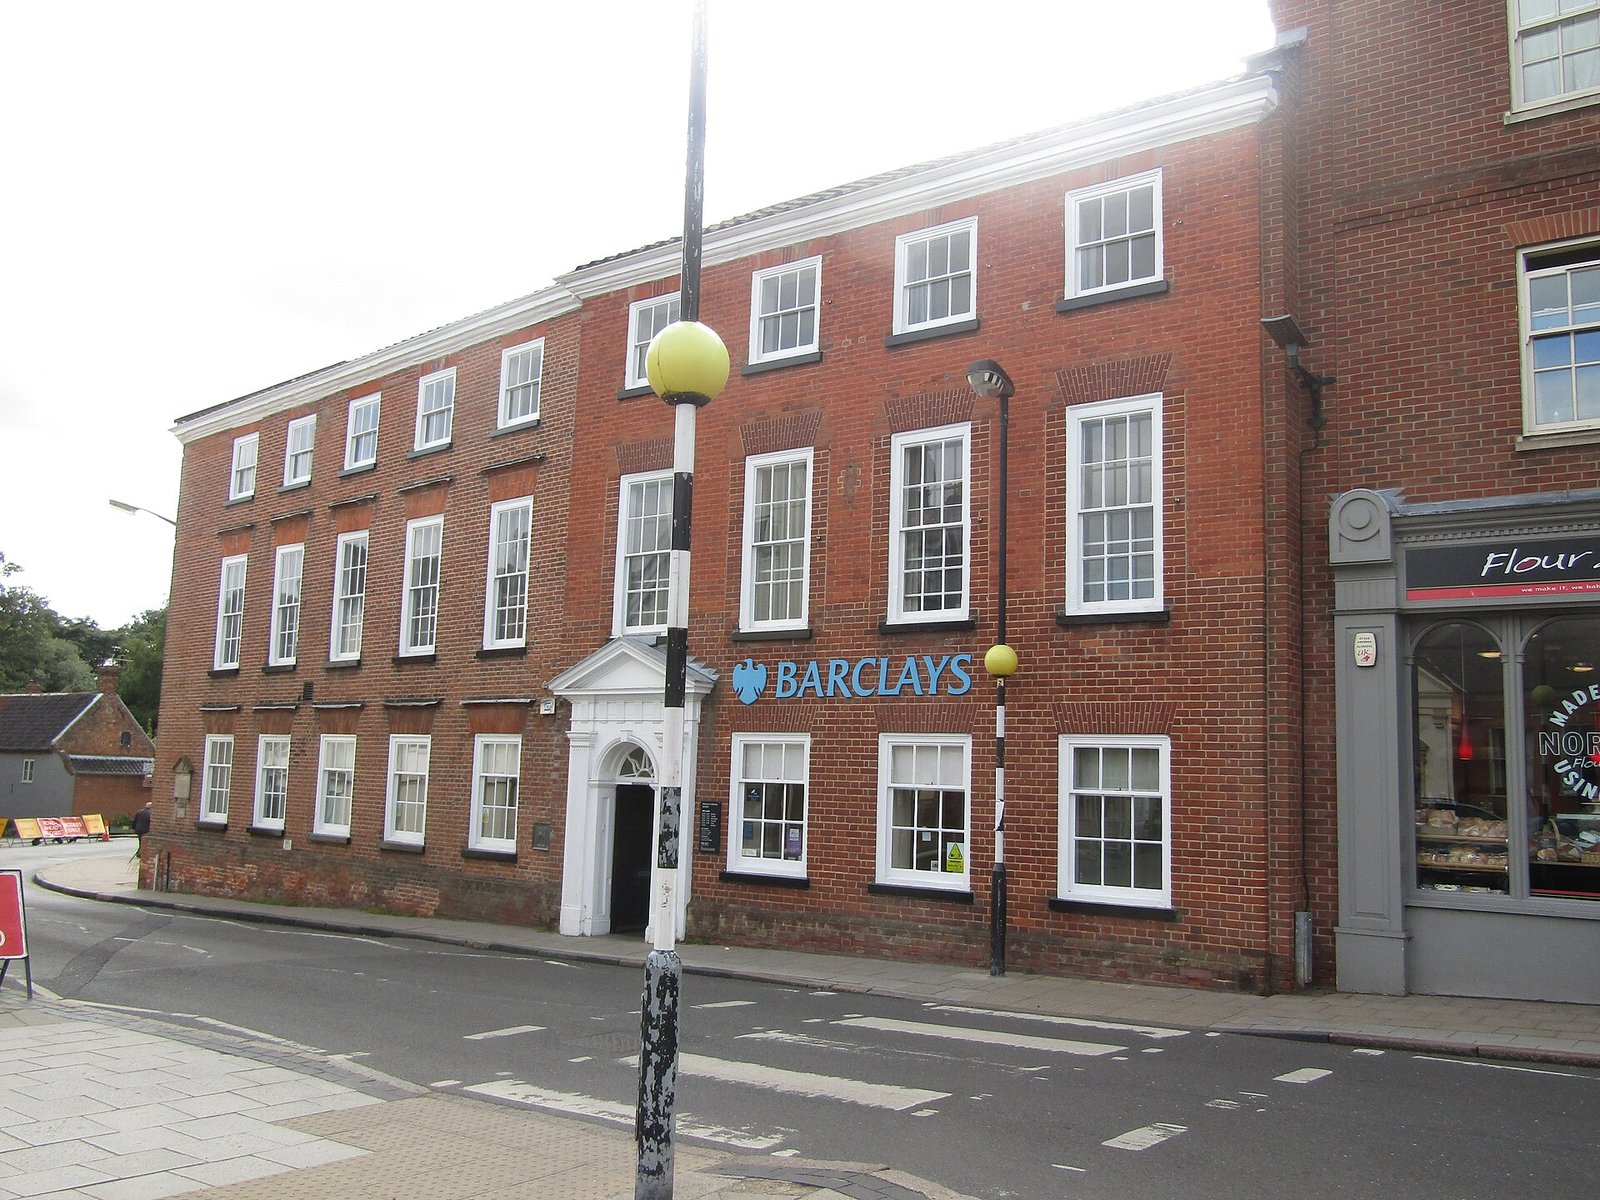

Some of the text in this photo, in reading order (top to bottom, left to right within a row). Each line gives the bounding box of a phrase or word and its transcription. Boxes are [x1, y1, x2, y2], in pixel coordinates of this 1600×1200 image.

[1481, 548, 1593, 577] Flour
[775, 654, 972, 698] BARCLAYS
[1549, 684, 1600, 728] MADE
[1553, 759, 1600, 800] USIN
